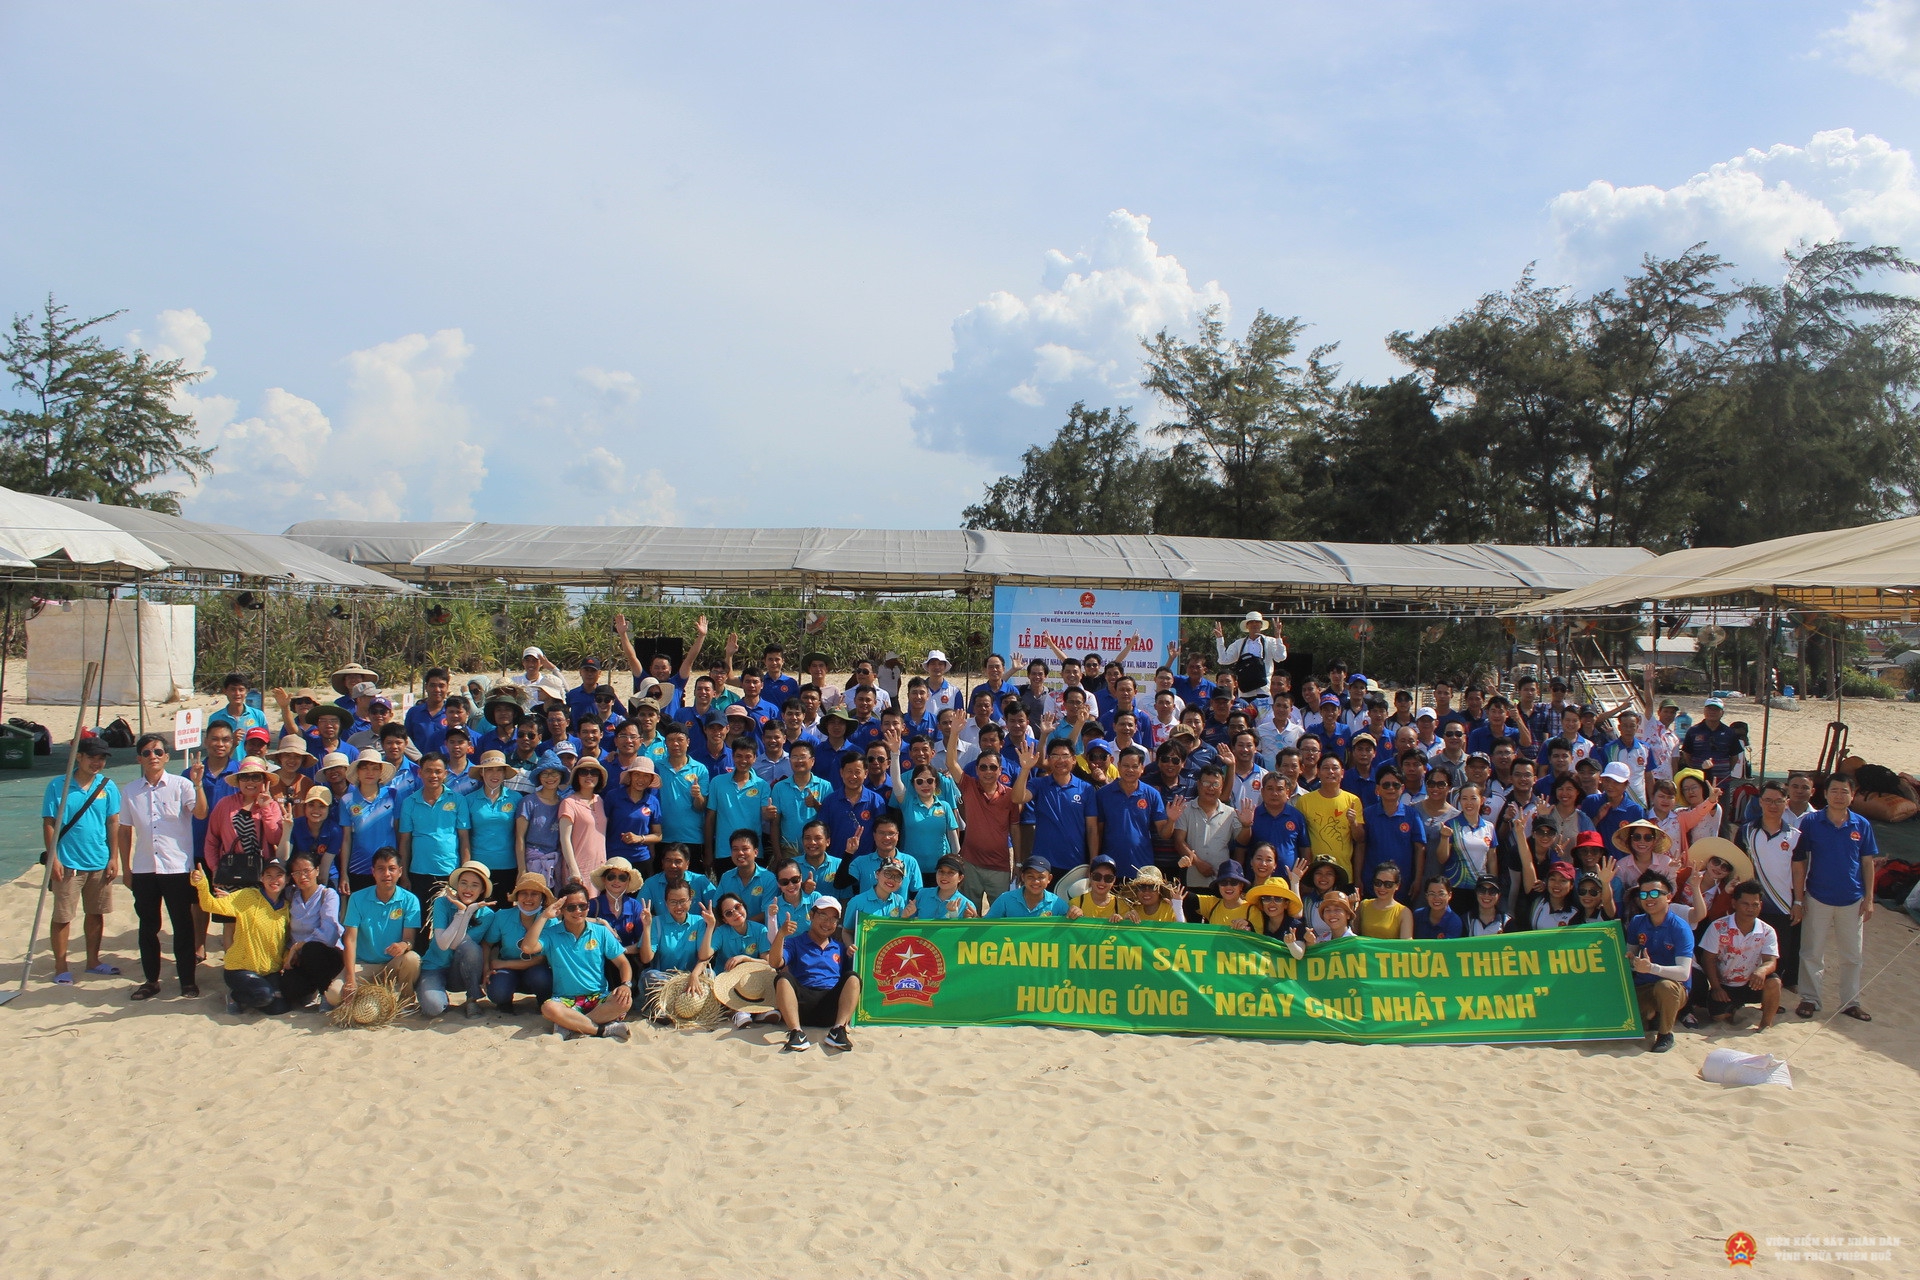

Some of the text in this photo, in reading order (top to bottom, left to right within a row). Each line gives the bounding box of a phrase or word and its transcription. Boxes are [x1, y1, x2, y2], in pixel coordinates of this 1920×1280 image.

[1018, 627, 1031, 648] LỄ
[1075, 631, 1099, 650] GIẢI
[1101, 630, 1122, 651] THỂ
[1147, 661, 1158, 669] 2020
[957, 935, 1606, 982] NGÀNH KIỂM SÁT NHÂN DÂN THỪA THIÊN HUẾ
[1016, 979, 1117, 1016] HƯỞNG
[1127, 984, 1188, 1016] ỨNG
[1304, 988, 1365, 1022] CHỦ
[1371, 991, 1447, 1027] NHẬT
